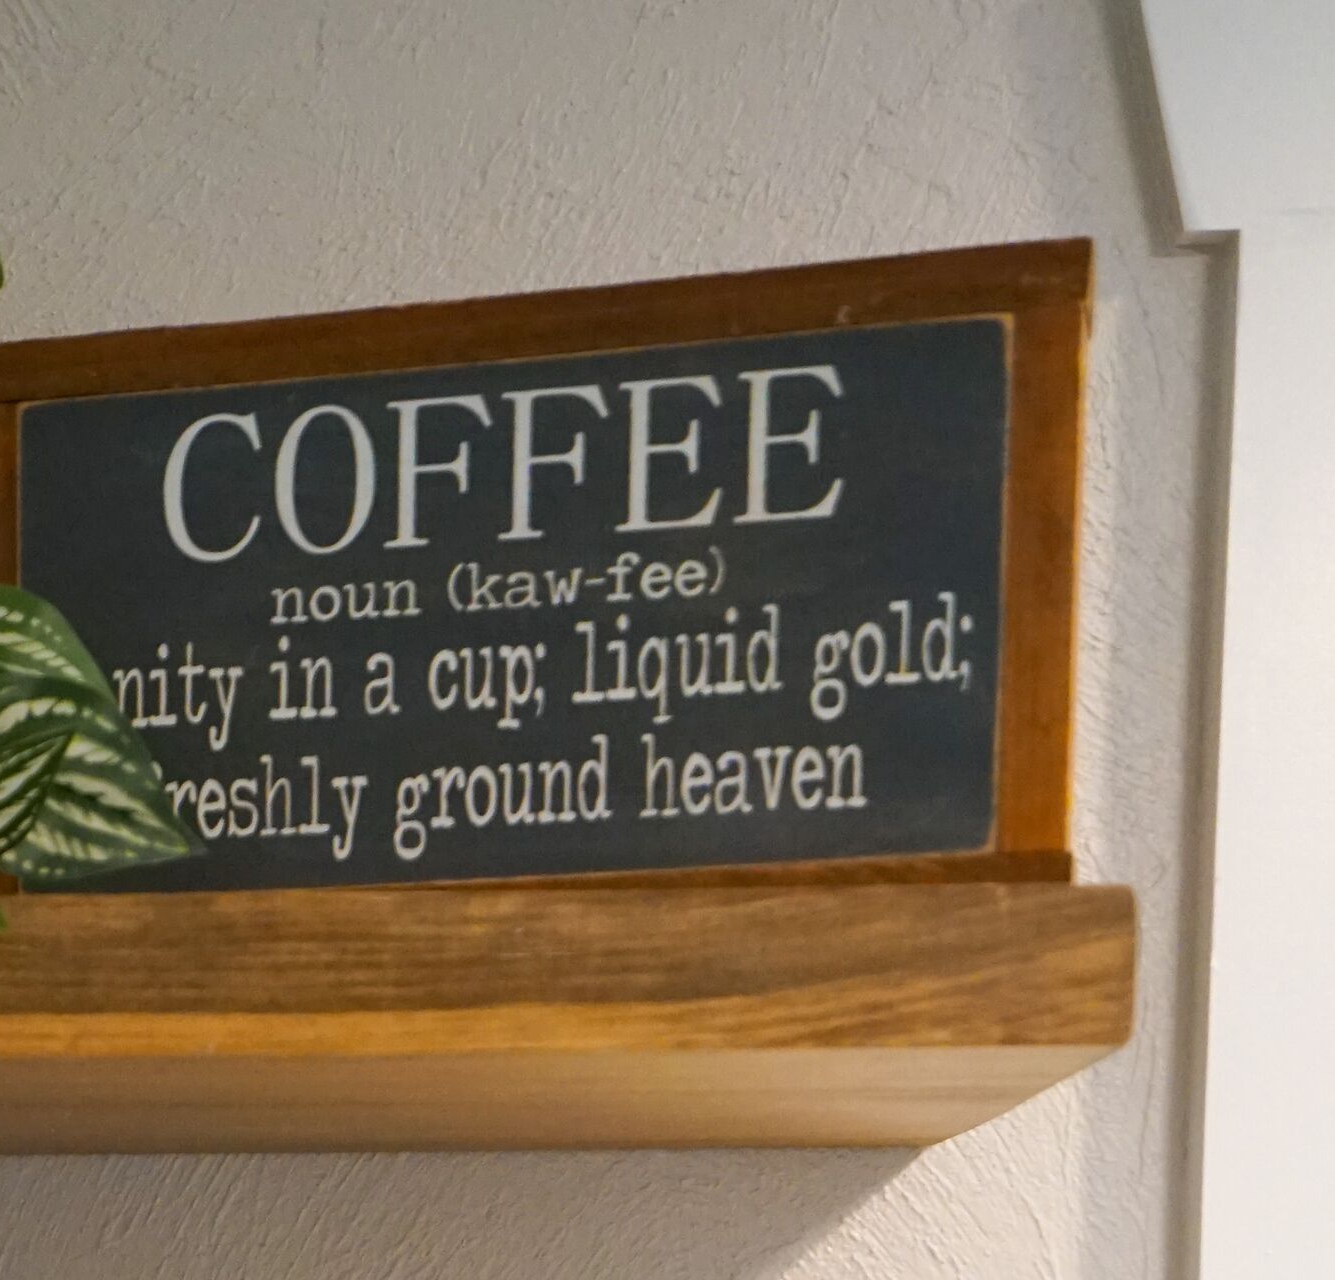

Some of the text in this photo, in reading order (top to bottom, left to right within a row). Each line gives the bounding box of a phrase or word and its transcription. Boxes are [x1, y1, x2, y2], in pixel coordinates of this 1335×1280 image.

[163, 363, 846, 564] COFFEE
[269, 545, 728, 625] noun (kaw-fee)
[112, 590, 974, 752] nity in a cup; liquid gold;
[152, 732, 868, 861] reshly ground heaven
